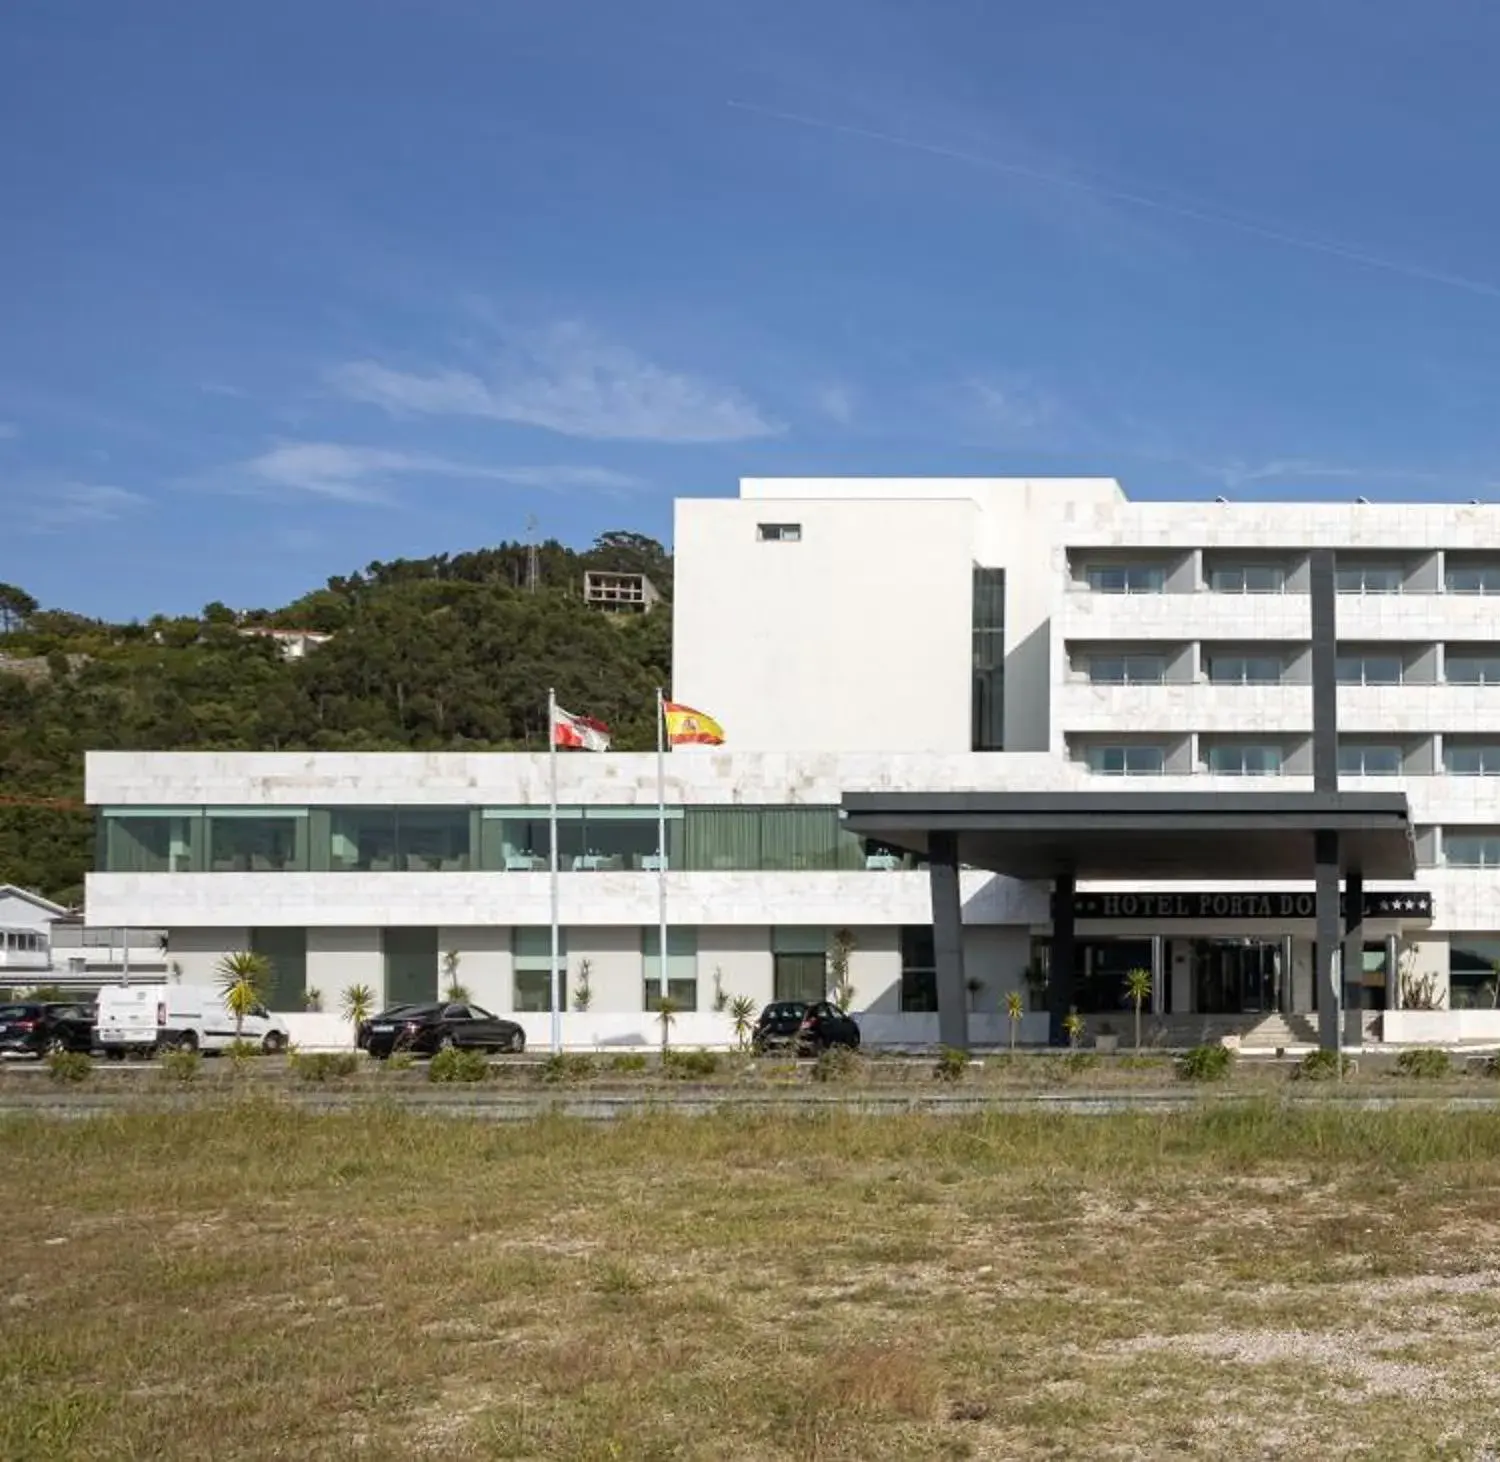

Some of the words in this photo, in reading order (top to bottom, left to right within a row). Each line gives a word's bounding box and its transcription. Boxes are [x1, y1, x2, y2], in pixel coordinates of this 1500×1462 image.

[1102, 895, 1190, 915] HOTEL
[1200, 895, 1272, 915] PORTA
[1280, 895, 1313, 915] DO
